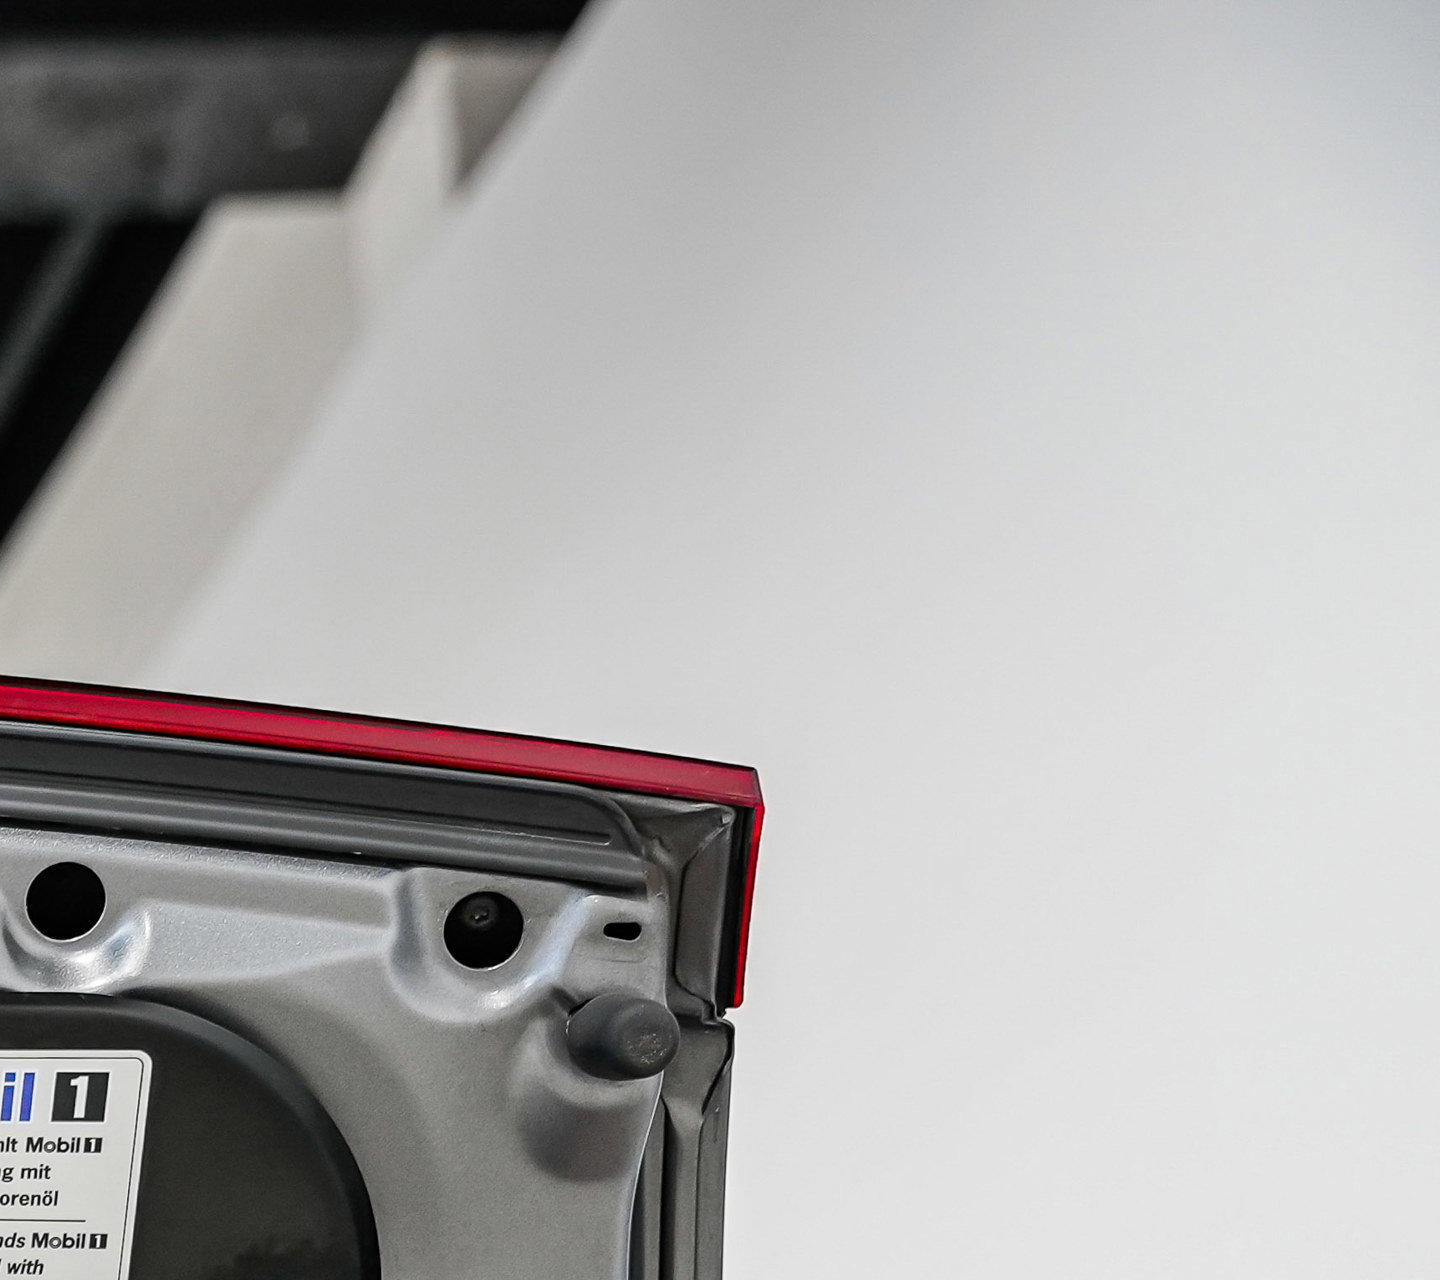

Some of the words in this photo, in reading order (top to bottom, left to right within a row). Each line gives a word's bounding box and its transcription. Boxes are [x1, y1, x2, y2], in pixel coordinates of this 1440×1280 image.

[25, 1136, 81, 1154] Mobil
[20, 1163, 52, 1180] mit
[31, 1232, 87, 1249] Mobil
[7, 1258, 44, 1275] with
